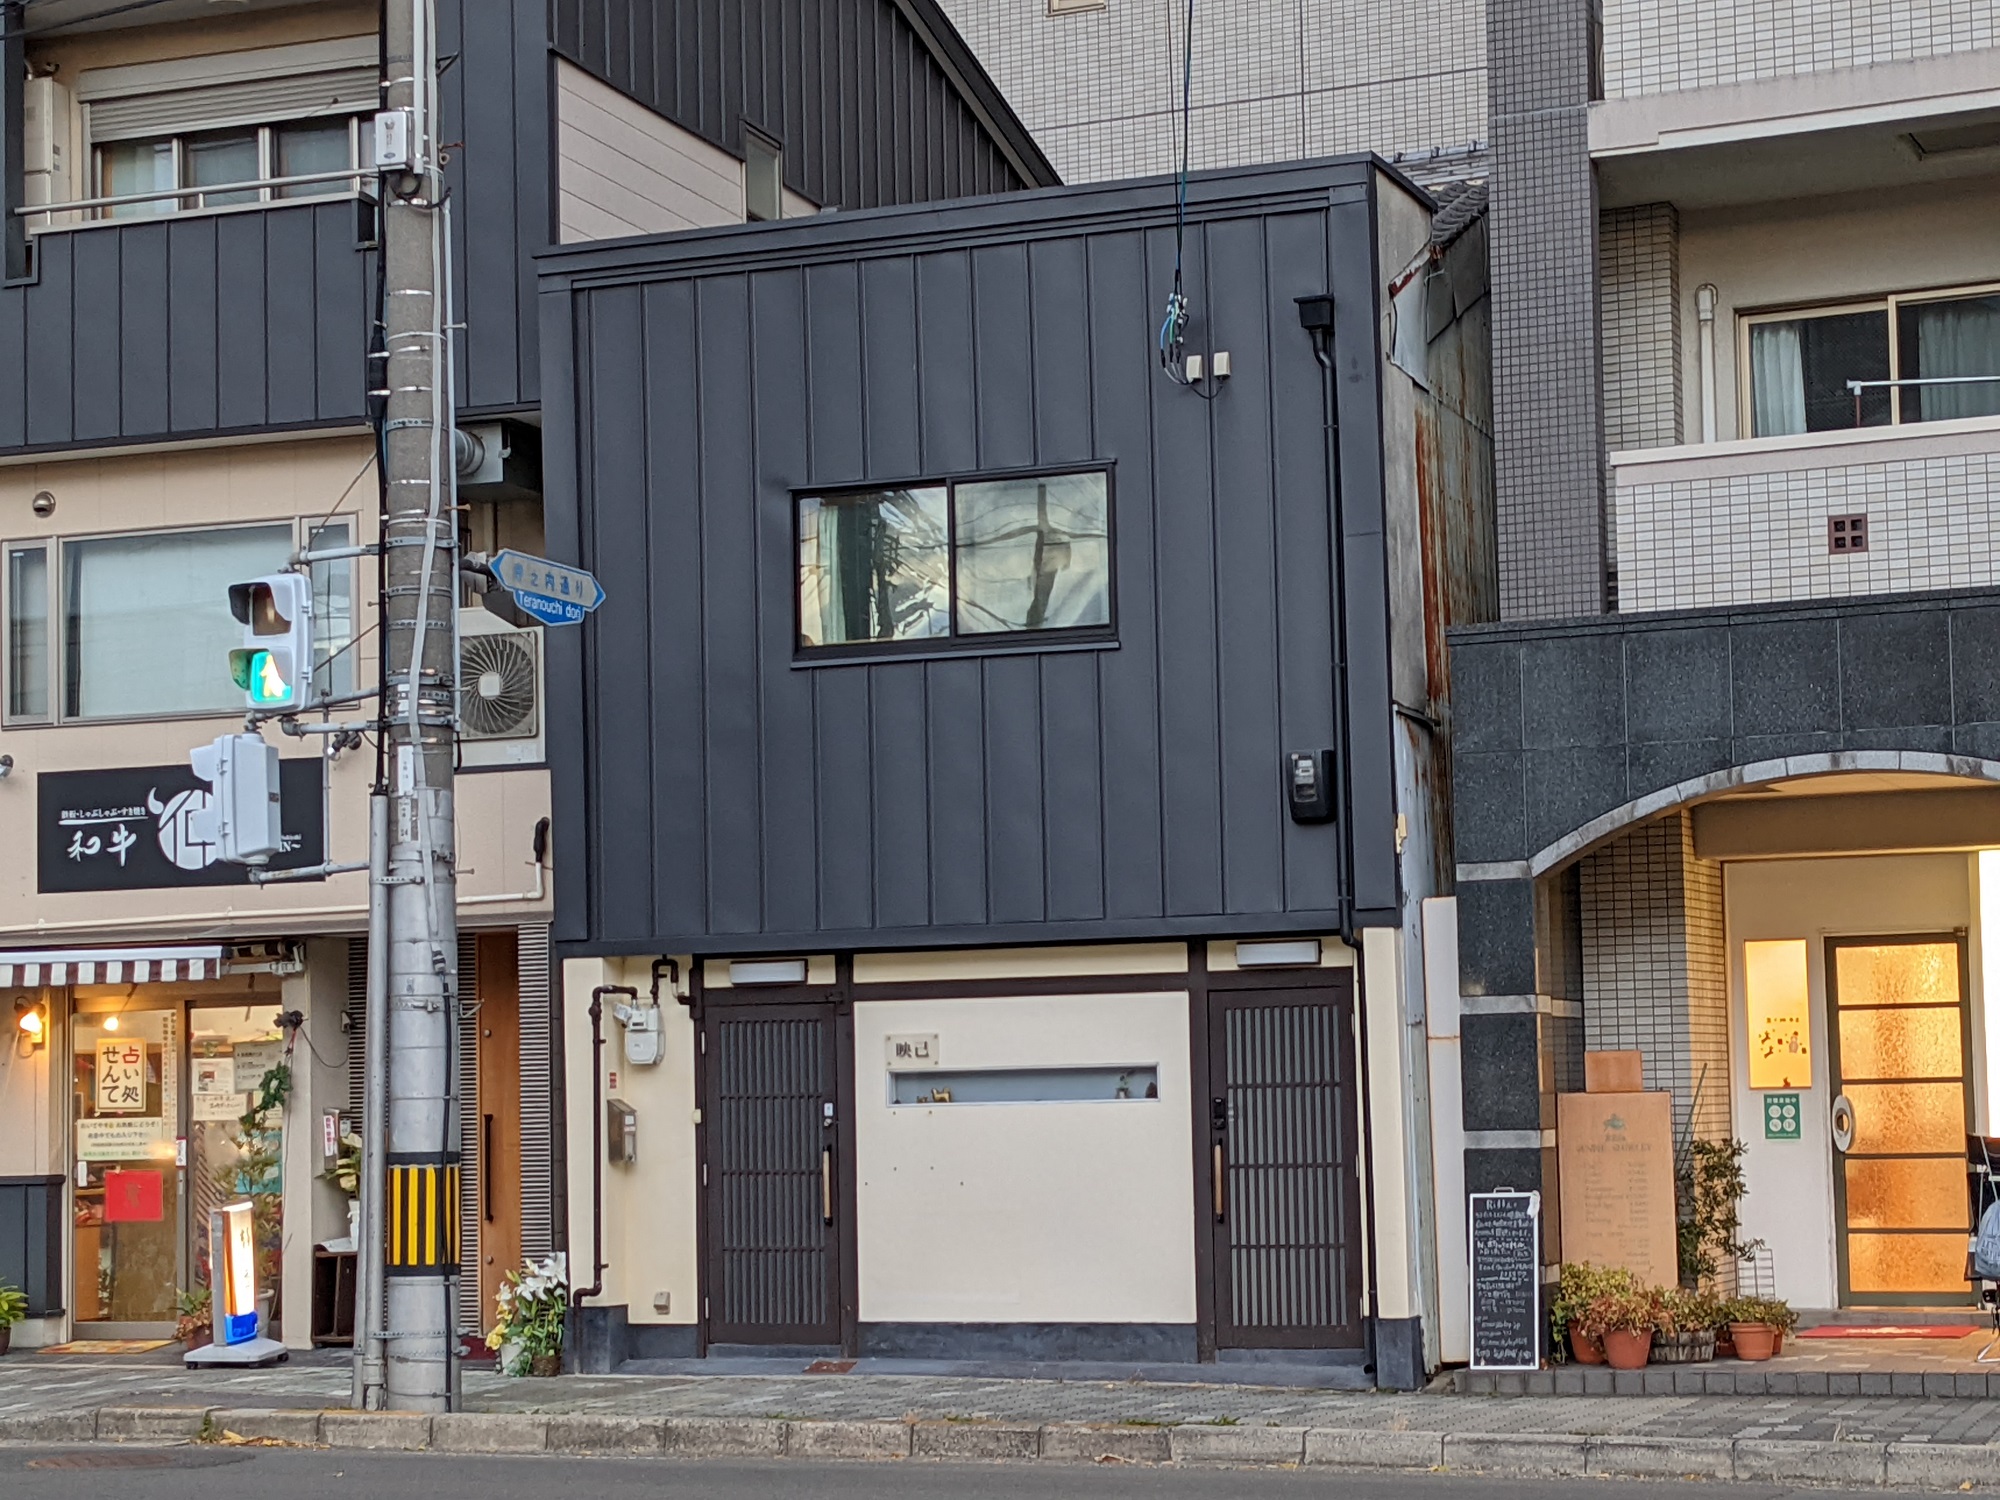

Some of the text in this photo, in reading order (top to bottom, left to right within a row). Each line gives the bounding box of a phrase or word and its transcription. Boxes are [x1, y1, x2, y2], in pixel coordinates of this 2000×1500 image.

[517, 590, 563, 615] Teranouchi
[66, 823, 137, 867] 和牛
[101, 1046, 120, 1104] せんて
[122, 1045, 140, 1104] 占い処
